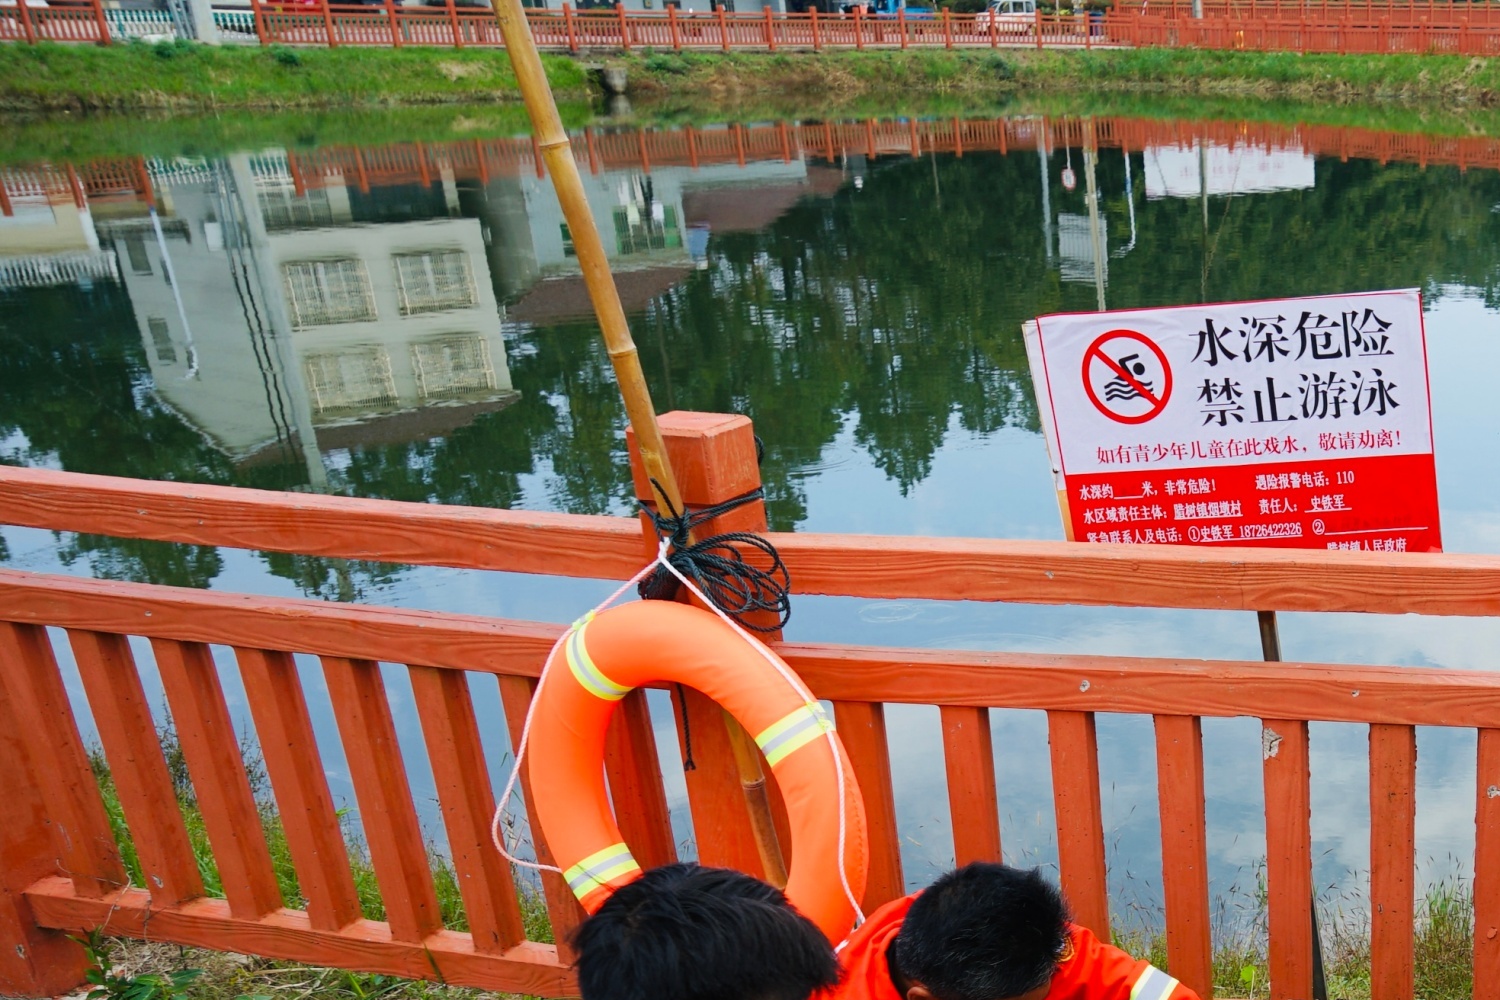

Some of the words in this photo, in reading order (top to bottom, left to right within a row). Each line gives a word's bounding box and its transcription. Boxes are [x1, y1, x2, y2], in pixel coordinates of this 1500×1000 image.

[1189, 308, 1395, 367] 水深危险
[1197, 368, 1400, 427] 禁止游泳
[1097, 430, 1402, 465] 如有青少年儿童在此戏水，敬请劝离！
